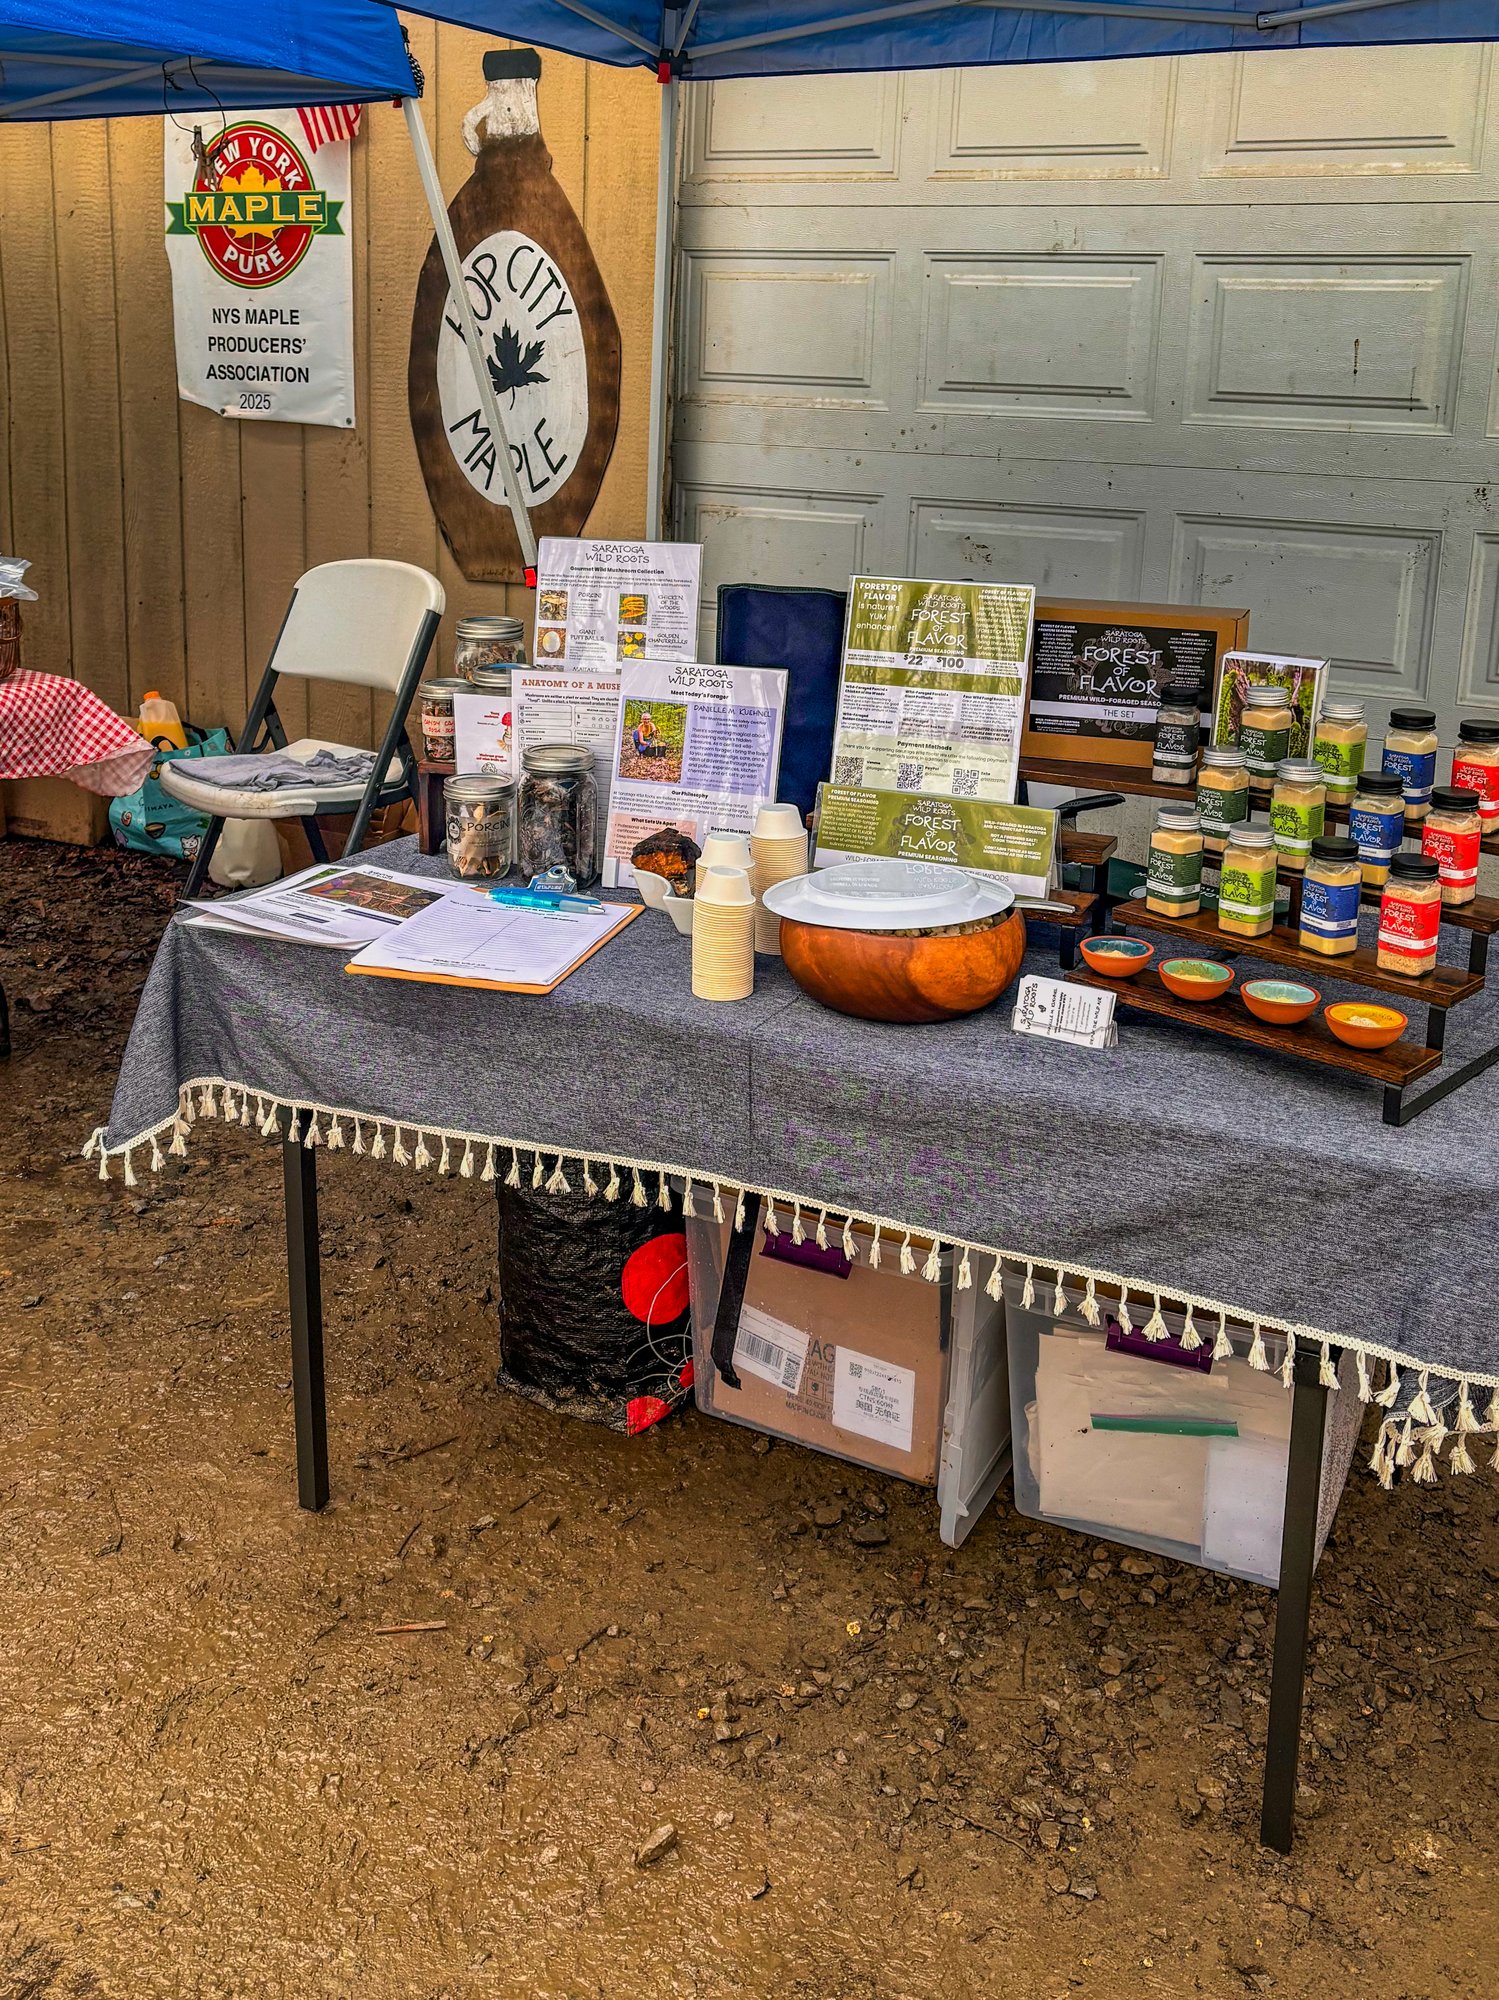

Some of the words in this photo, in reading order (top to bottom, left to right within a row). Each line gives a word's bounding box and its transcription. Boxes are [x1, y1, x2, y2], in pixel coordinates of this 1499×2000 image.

[249, 137, 303, 191] YORK
[188, 194, 324, 222] MAPLE
[222, 244, 285, 275] PURE
[506, 245, 573, 331] CITY
[211, 307, 241, 325] NYS
[245, 309, 300, 326] MAPLE
[207, 336, 306, 354] PRODUCERS'
[205, 364, 310, 384] ASSOCIATION
[239, 393, 271, 410] 2025
[591, 543, 645, 555] SARATOGA
[585, 552, 613, 563] WILD
[615, 554, 650, 564] ROOTS
[570, 565, 594, 573] Gourmet
[859, 582, 891, 591] FOREST
[891, 584, 903, 592] OF
[863, 592, 897, 602] FLAVOR
[922, 593, 963, 603] SARATOGA
[866, 603, 900, 612] nature's
[917, 599, 939, 608] WILD
[940, 601, 967, 610] ROOTS
[869, 612, 887, 621] YUM
[910, 608, 971, 625] FOREST
[856, 622, 897, 632] enhancer!
[932, 624, 946, 632] OF
[1104, 629, 1144, 638] SARATOGA
[907, 630, 968, 650] FLAVOR
[1100, 635, 1121, 644] WILD
[1122, 637, 1148, 645] ROOTS
[903, 653, 924, 666] $22
[936, 655, 965, 669] $100
[1082, 646, 1164, 667] FOREST
[674, 666, 728, 679] SARATOGA
[1112, 666, 1131, 677] OF
[521, 678, 569, 689] ANATOMY
[571, 681, 584, 689] OF
[668, 675, 695, 687] WILD
[698, 678, 734, 689] ROOTS
[1079, 675, 1161, 699] FLAVOR
[684, 690, 706, 699] Today's
[707, 693, 729, 701] Forager
[1058, 693, 1089, 702] PREMIUM
[1089, 696, 1140, 706] WILD-FORAGED
[1140, 700, 1162, 708] SEASO
[693, 704, 727, 714] DANIELLE
[1103, 708, 1119, 717] THE
[1120, 710, 1135, 719] SET
[1158, 732, 1187, 741] FOREST
[1240, 735, 1268, 746] FOREST
[897, 740, 925, 750] Payment
[924, 742, 952, 752] Methods
[1157, 742, 1186, 753] FLAVOR
[1384, 760, 1414, 772] FOREST
[1456, 772, 1489, 784] FOREST
[681, 791, 709, 799] Philosophy
[850, 797, 879, 805] SEASONING
[857, 791, 877, 799] FLAVOR
[1197, 795, 1225, 807] FOREST
[917, 799, 953, 809] SARATOGA
[912, 805, 931, 813] WILD
[933, 808, 956, 816] ROOTS
[904, 813, 962, 831] FOREST
[1352, 821, 1384, 832] FOREST
[710, 826, 729, 835] Beyond
[925, 830, 938, 839] OF
[1350, 832, 1383, 846] FLAVOR
[900, 835, 959, 856] FLAVOR
[1424, 839, 1457, 853] FOREST
[897, 850, 924, 859] PREMIUM
[924, 854, 958, 864] SEASONING
[1150, 857, 1176, 870] FOREST
[1148, 869, 1176, 884] FLAVOR
[1303, 889, 1330, 904] FOREST
[1302, 901, 1329, 917] FLAVOR
[1384, 908, 1417, 922] FOREST
[1382, 920, 1416, 937] FLAVOR
[1020, 985, 1032, 1025] SARATOGA
[1025, 1009, 1035, 1030] WILD
[1030, 983, 1038, 1008] ROOTS
